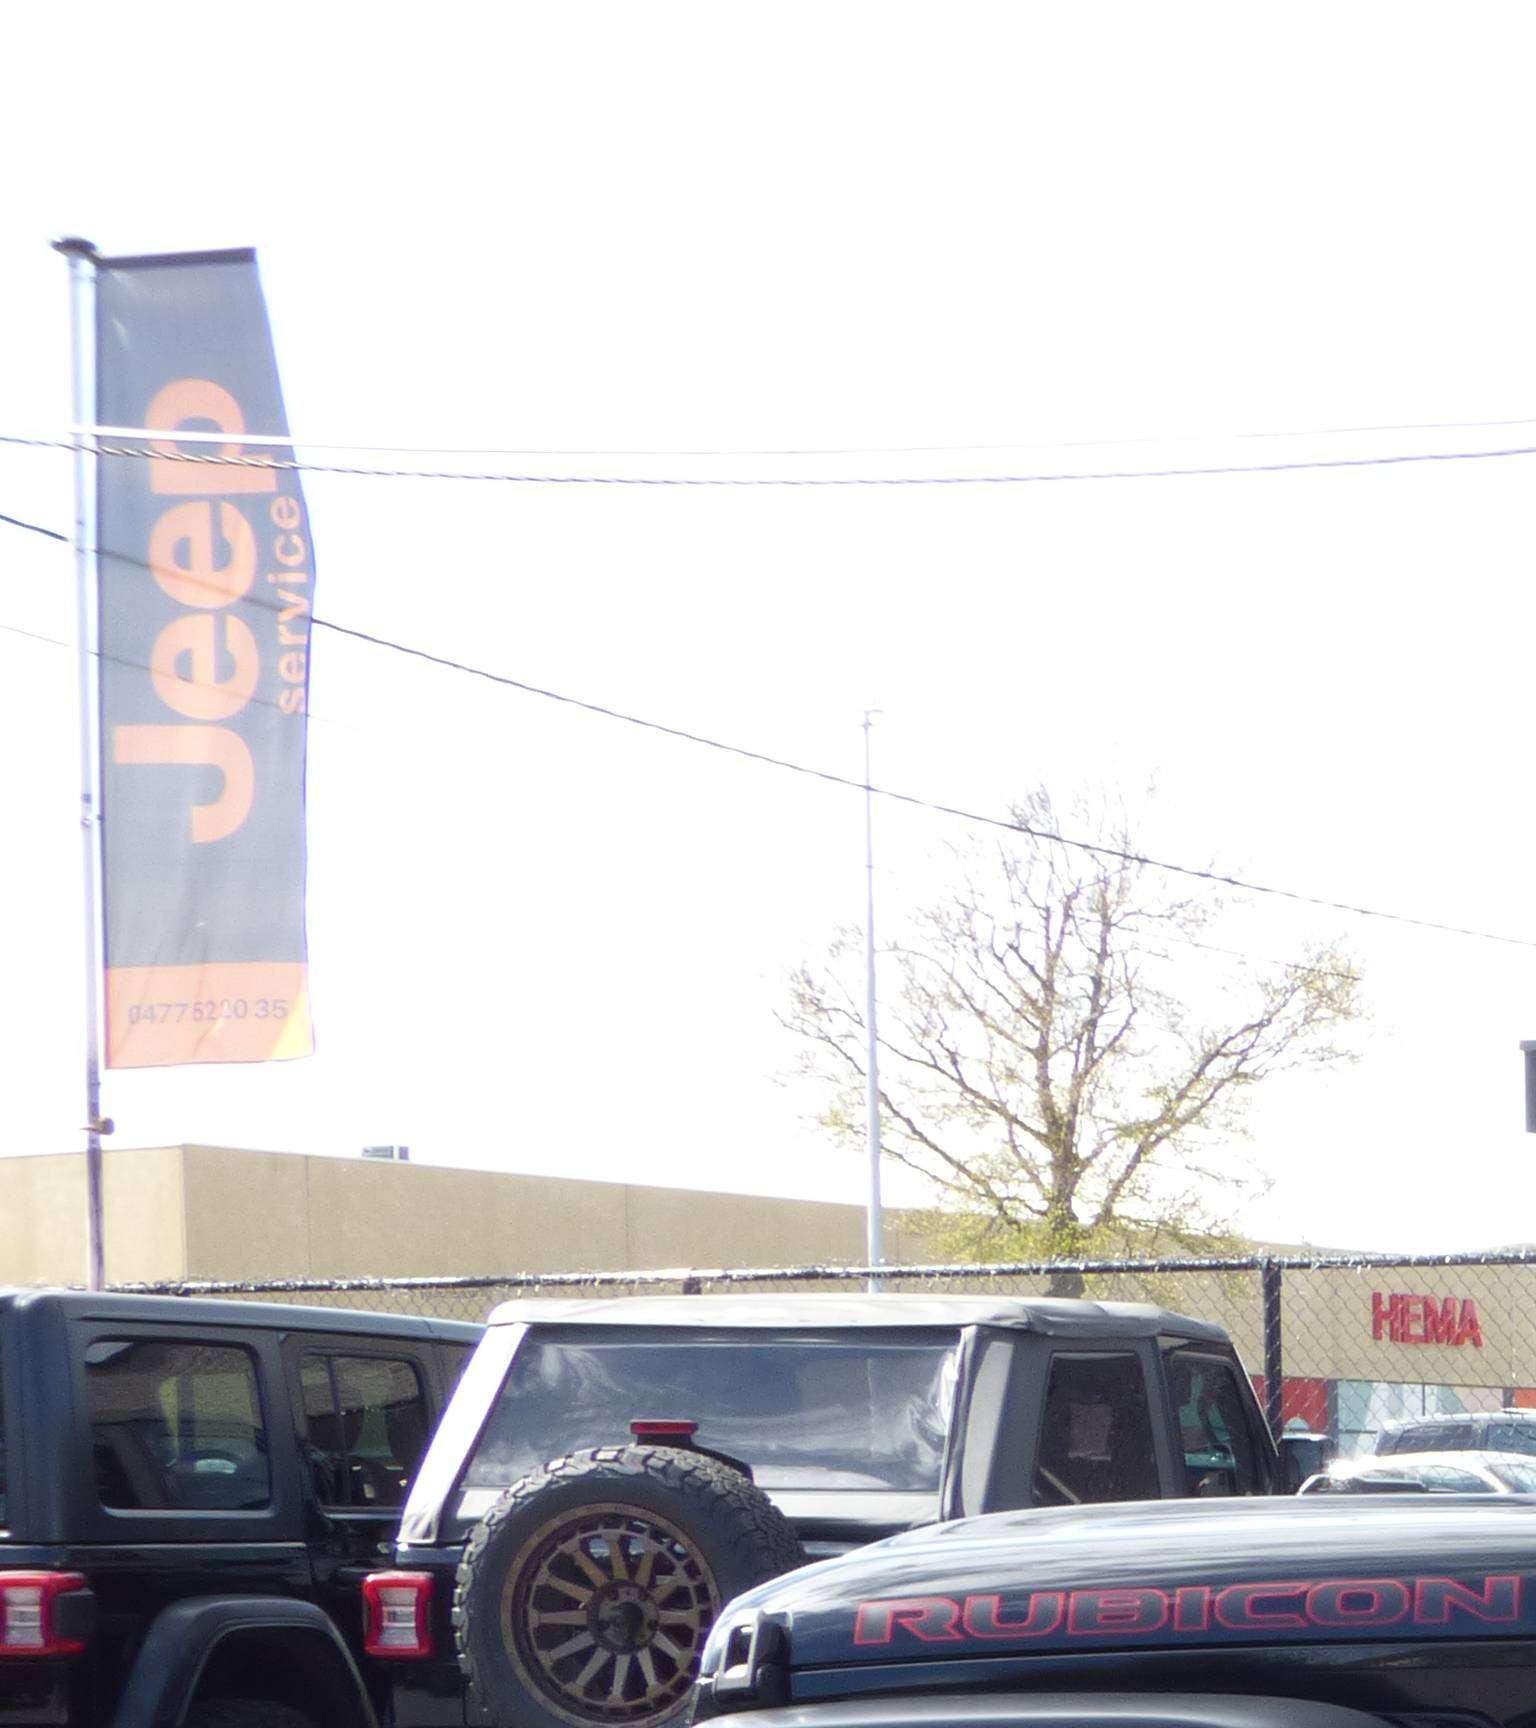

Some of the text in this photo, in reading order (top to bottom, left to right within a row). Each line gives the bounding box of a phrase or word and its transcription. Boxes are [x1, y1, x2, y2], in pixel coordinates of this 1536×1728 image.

[114, 377, 277, 843] Jeep
[266, 495, 308, 715] service
[1372, 1291, 1483, 1347] HEMA
[853, 1575, 1521, 1645] RUBICON
